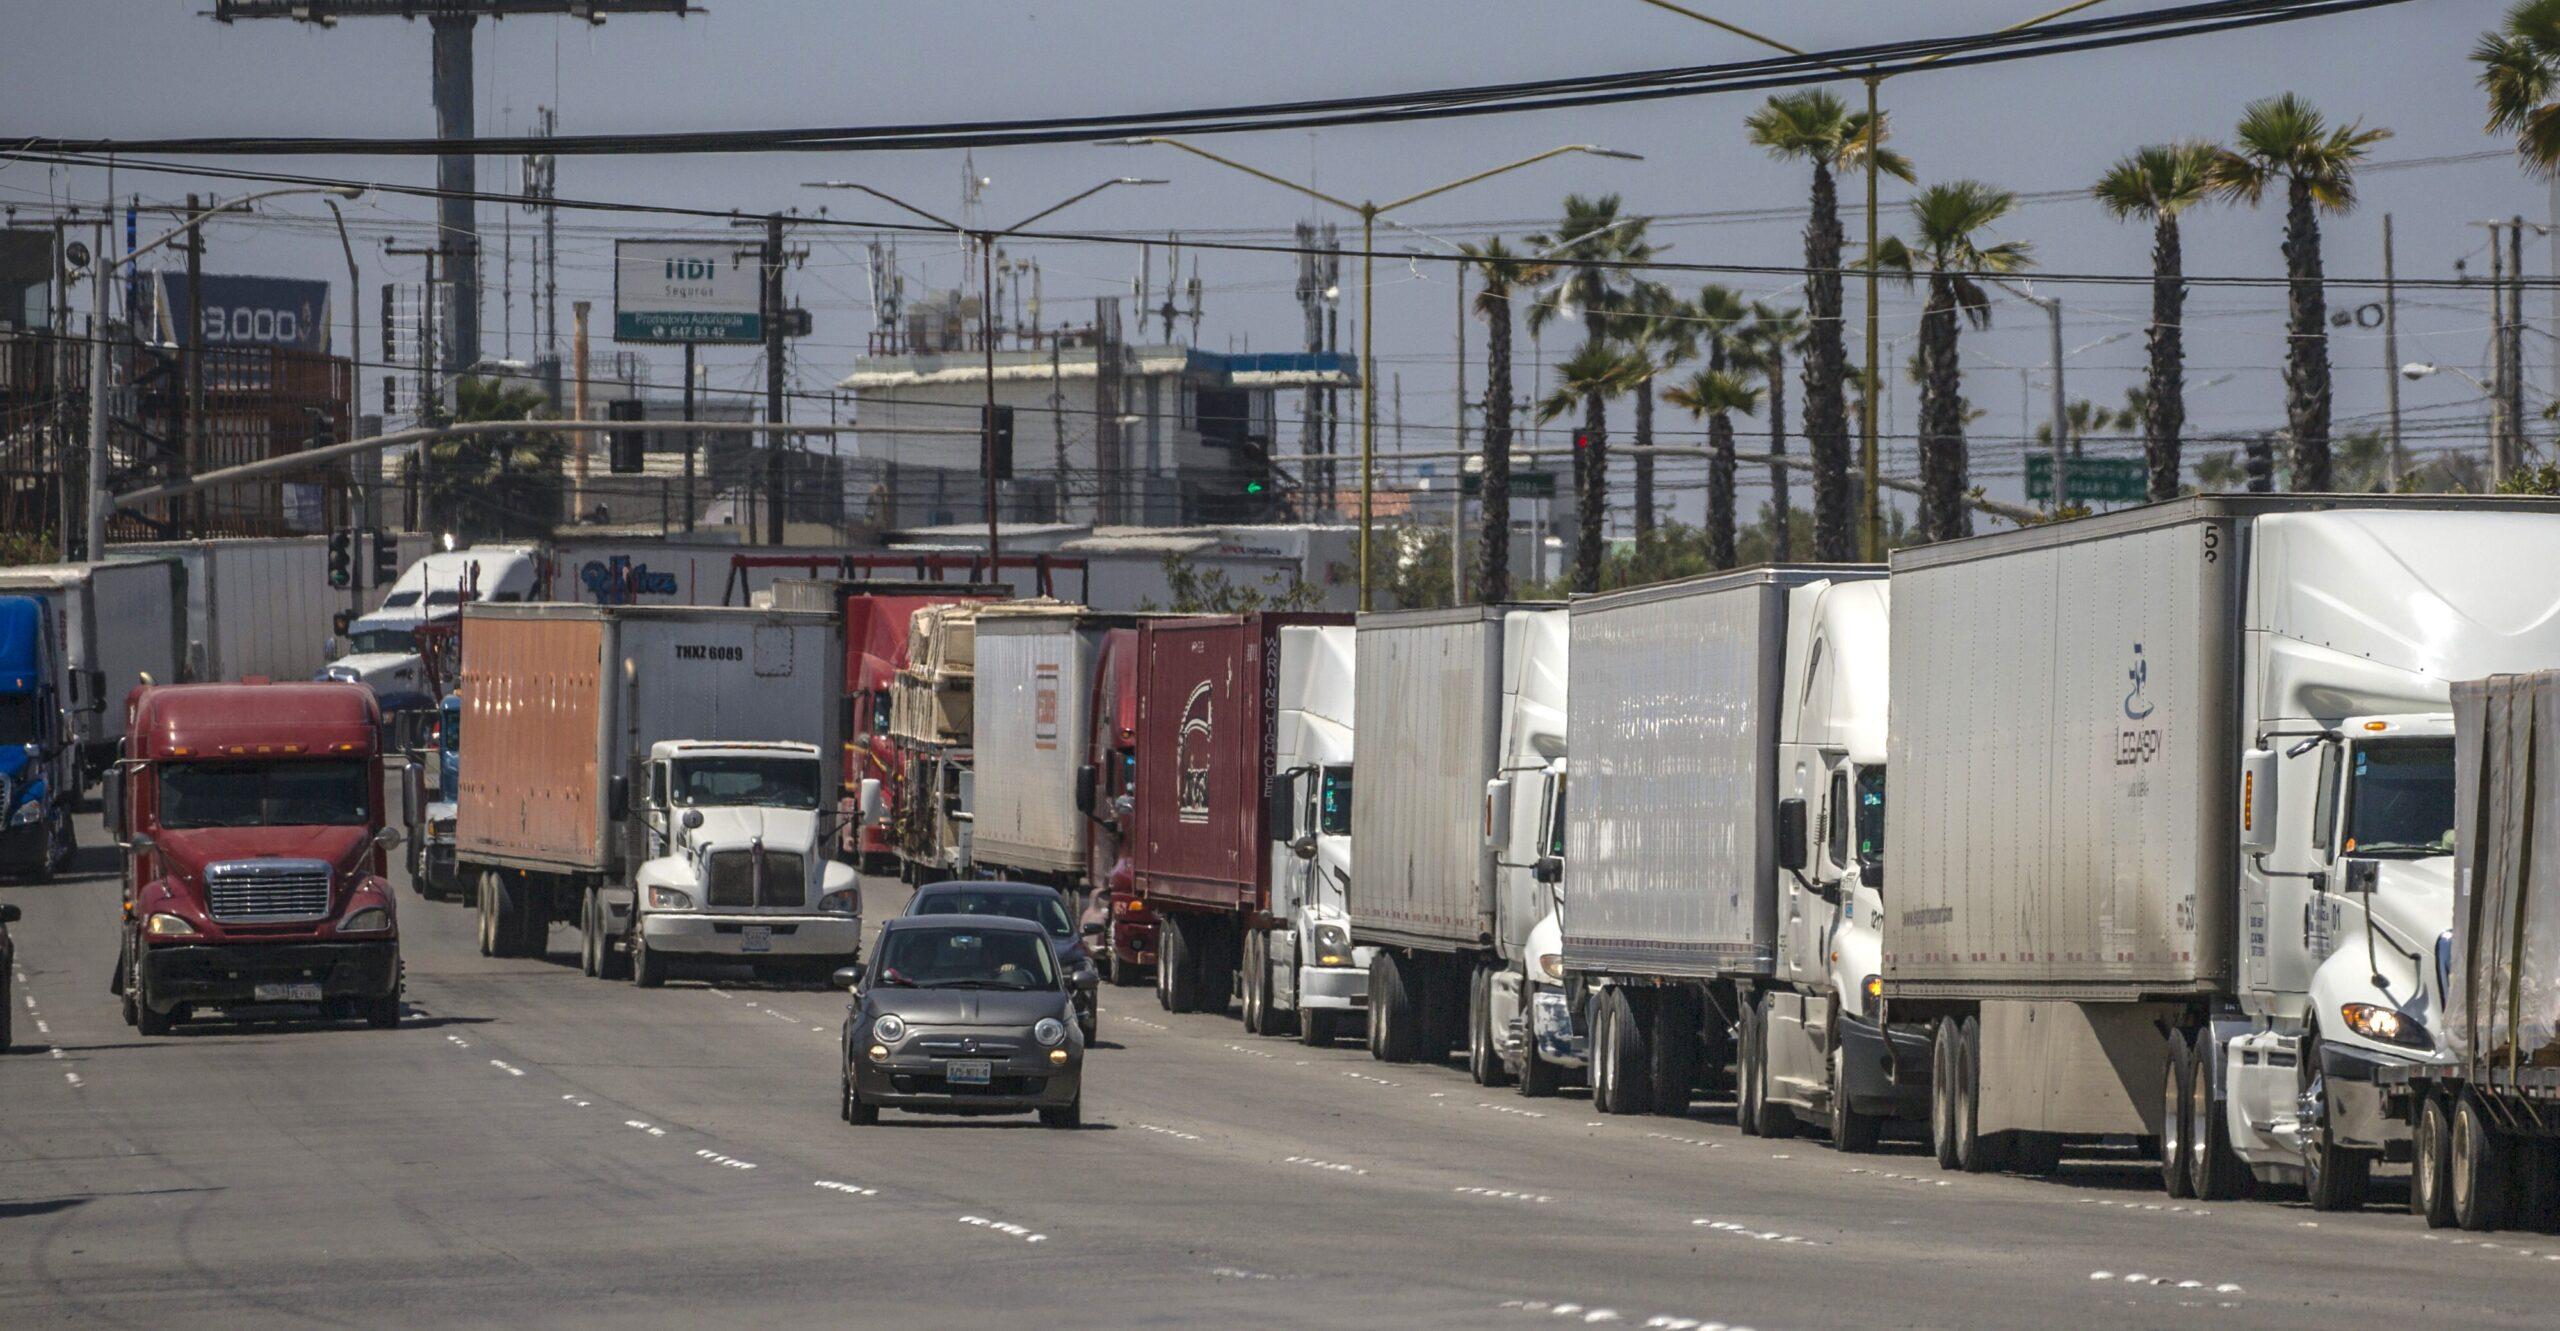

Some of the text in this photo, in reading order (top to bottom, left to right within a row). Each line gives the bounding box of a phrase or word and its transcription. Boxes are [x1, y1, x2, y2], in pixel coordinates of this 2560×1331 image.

[709, 646, 743, 661] 6089
[1264, 636, 1279, 709] WARNING
[1264, 713, 1277, 756] HIGH
